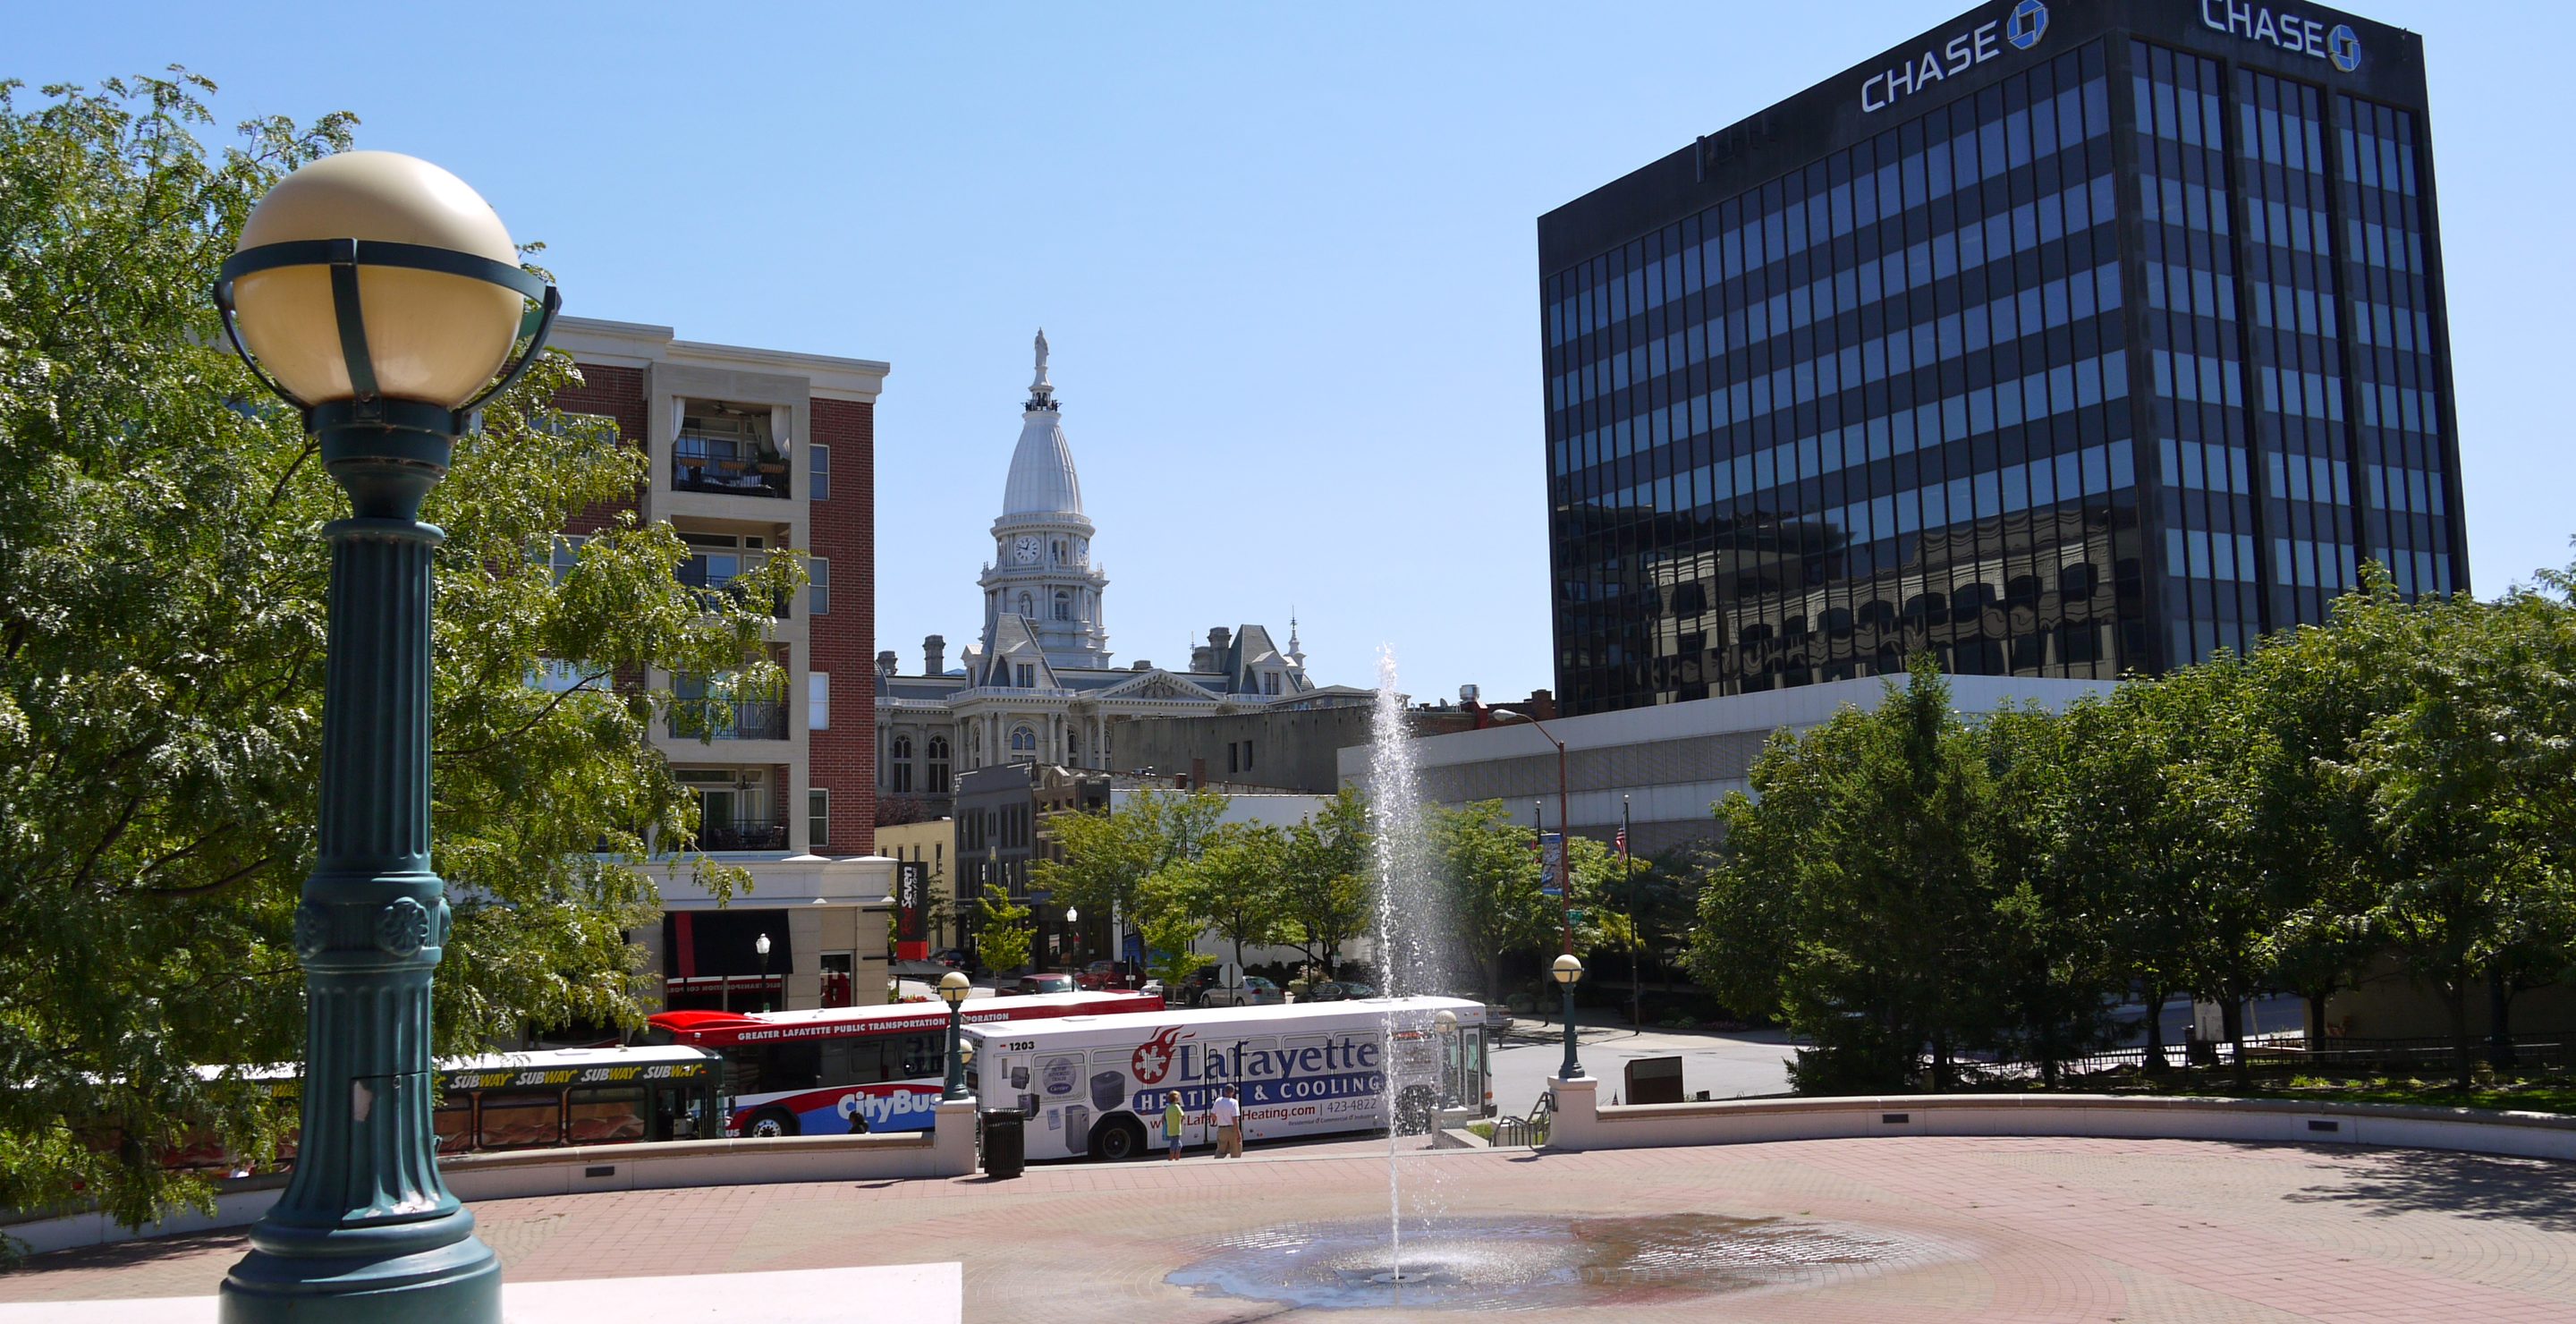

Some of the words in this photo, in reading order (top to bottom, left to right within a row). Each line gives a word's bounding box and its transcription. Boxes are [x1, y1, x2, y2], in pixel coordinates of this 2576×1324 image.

[2202, 0, 2326, 58] CHASE
[1861, 20, 2000, 113] CHASE
[902, 866, 912, 909] Seven
[738, 1029, 780, 1040] GREATER
[783, 1026, 831, 1038] LAFAYETTE
[834, 1023, 866, 1034] PUBLIC
[869, 1017, 945, 1031] TRANSPORTATION
[1009, 1040, 1035, 1051] 1203
[450, 1074, 513, 1090] SUBWAY
[515, 1070, 580, 1086] SUBWAY
[581, 1066, 642, 1082] SUBWAY
[643, 1064, 703, 1079] SUBWAY
[1179, 1038, 1378, 1082] Lafayette
[837, 1090, 943, 1124] CityBus
[1140, 1086, 1240, 1110] HETIN
[1254, 1083, 1269, 1101] &
[1280, 1074, 1380, 1099] COOLING
[1327, 1098, 1377, 1113] 423-4822
